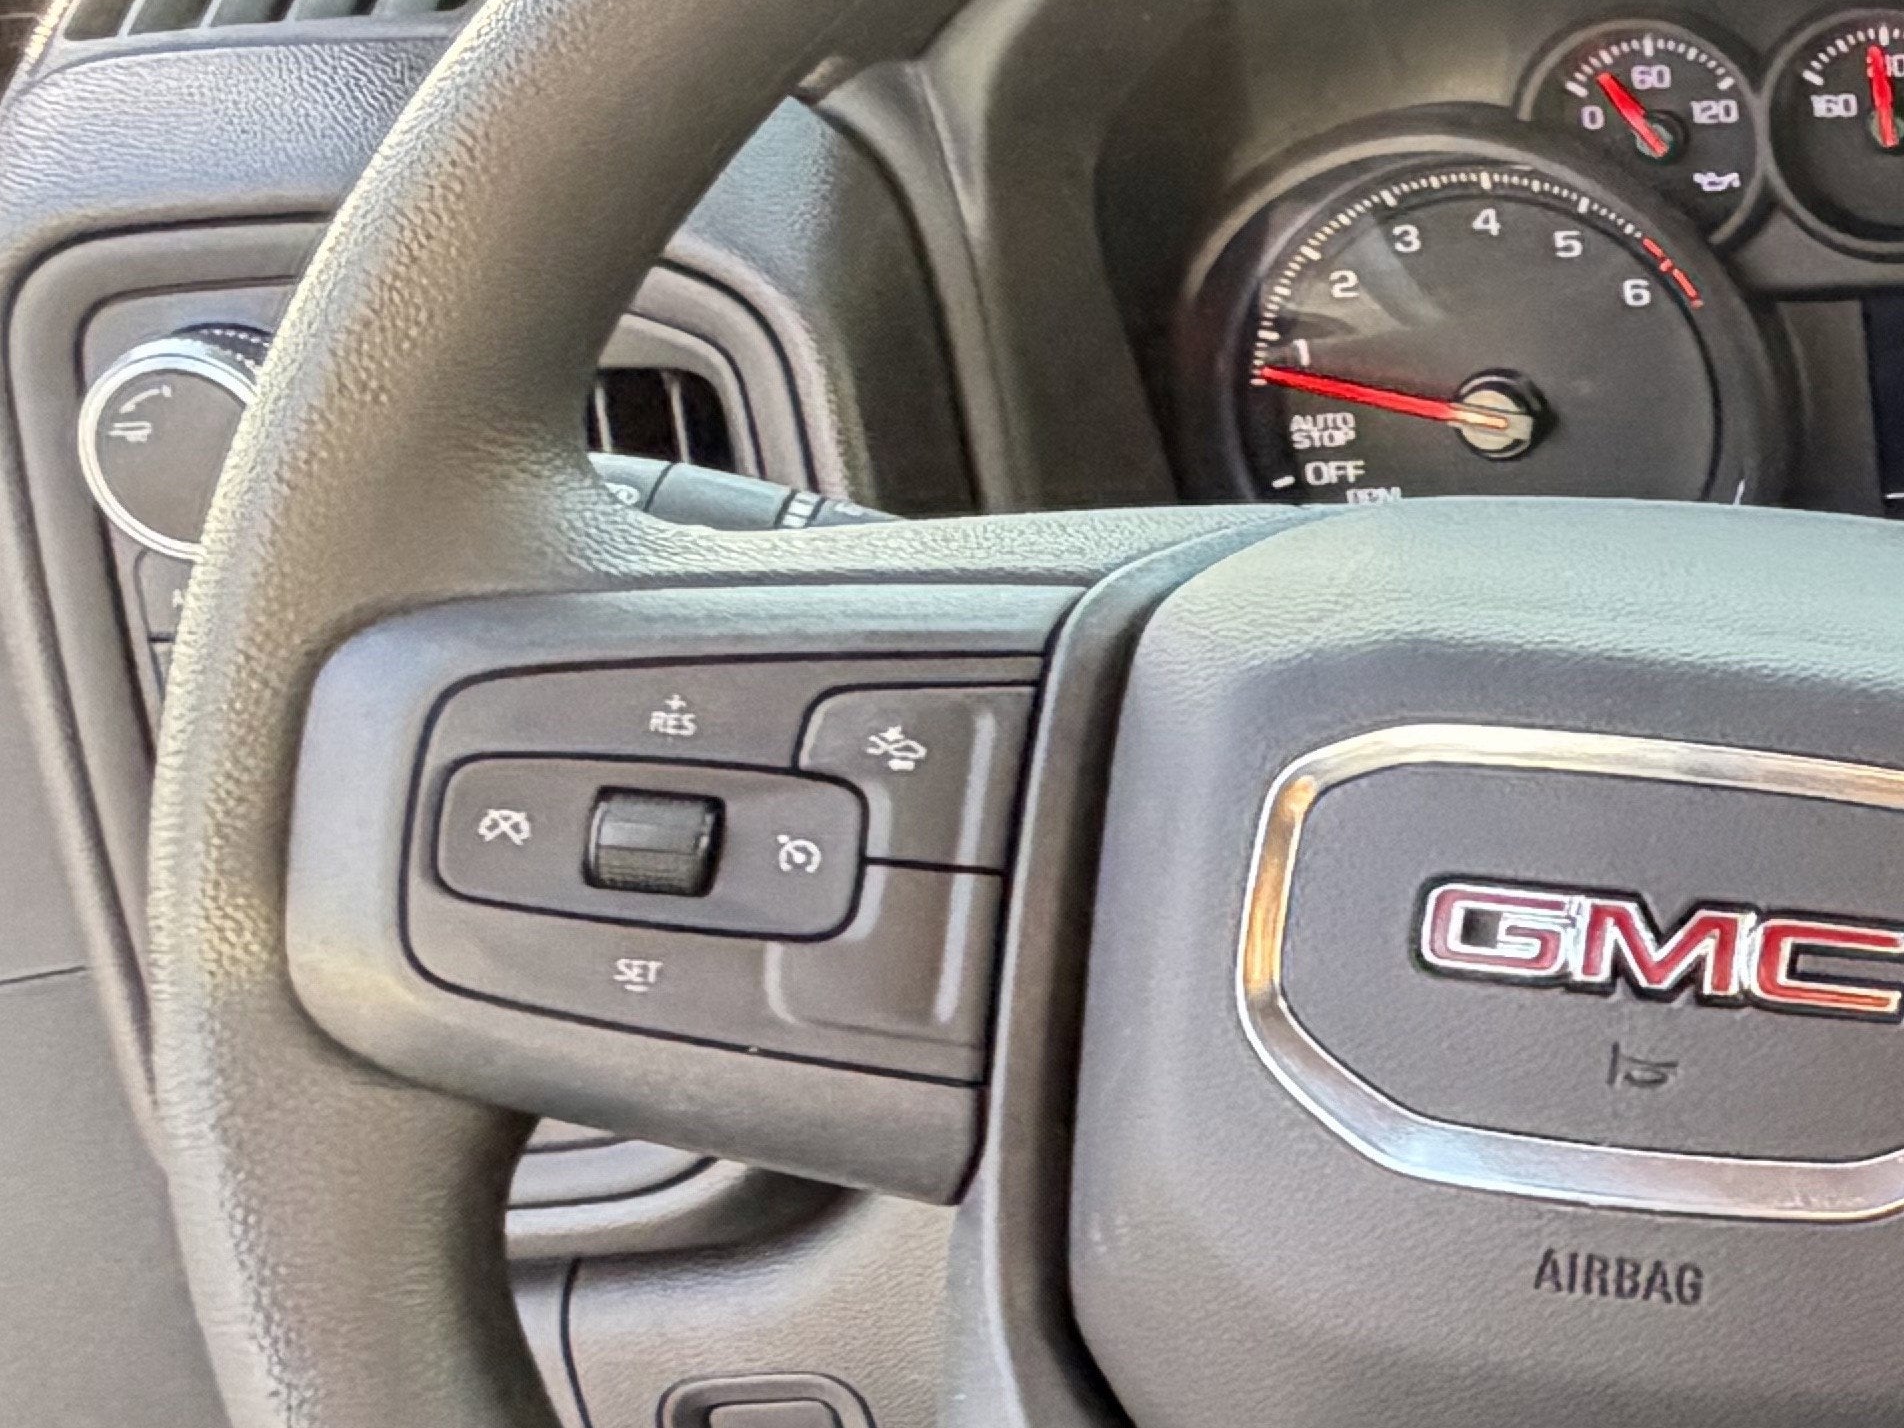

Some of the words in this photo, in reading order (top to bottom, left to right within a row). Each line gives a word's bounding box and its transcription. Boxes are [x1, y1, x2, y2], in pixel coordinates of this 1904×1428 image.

[1631, 65, 1671, 90] 60
[1581, 106, 1605, 130] 0
[1691, 100, 1739, 124] 120
[1811, 95, 1858, 118] 160
[1472, 209, 1500, 236] 4
[1393, 225, 1421, 253] 3
[1554, 231, 1583, 258] 5
[1330, 270, 1359, 298] 2
[1623, 279, 1651, 307] 6
[1293, 339, 1311, 366] 1
[1290, 412, 1355, 431] AUTO
[1291, 429, 1356, 449] STOP
[1304, 461, 1366, 485] OFF
[650, 711, 697, 736] RES
[613, 959, 662, 983] SET
[1533, 1248, 1705, 1306] AIRBAG
